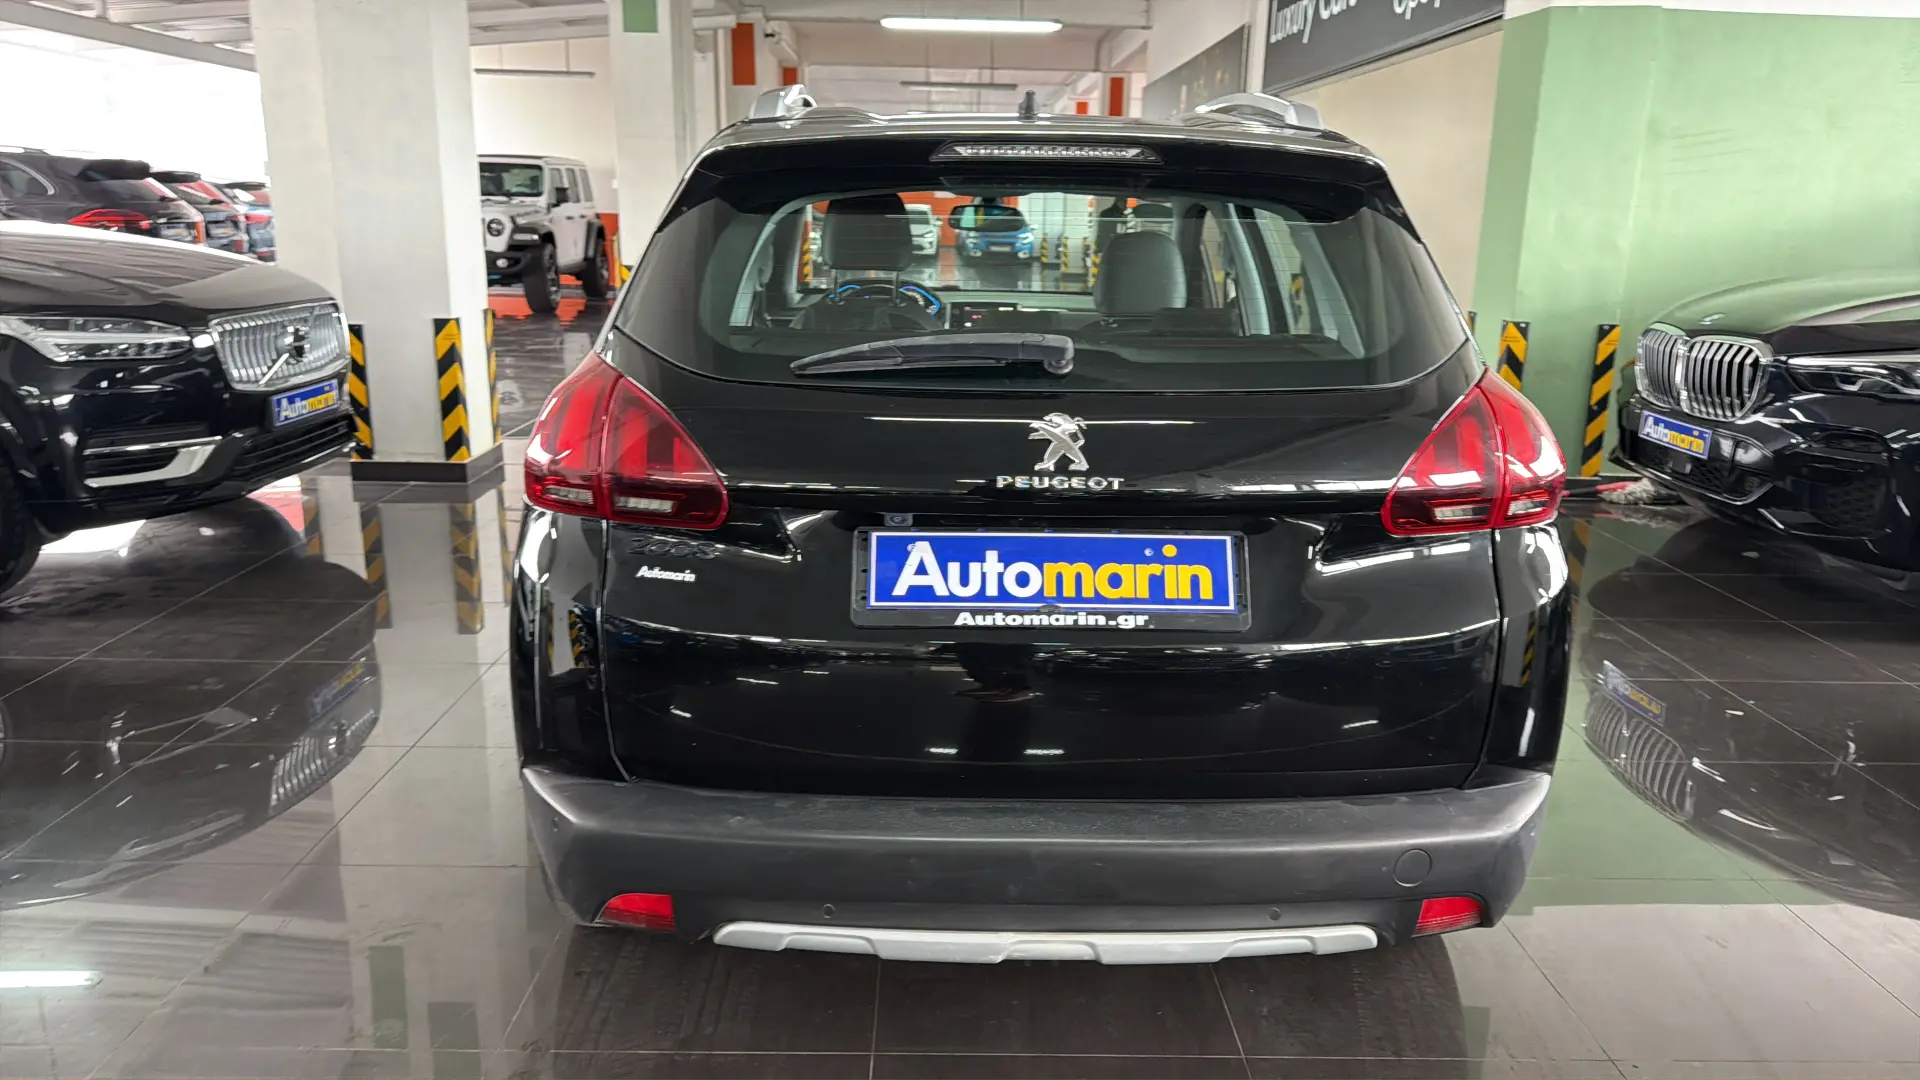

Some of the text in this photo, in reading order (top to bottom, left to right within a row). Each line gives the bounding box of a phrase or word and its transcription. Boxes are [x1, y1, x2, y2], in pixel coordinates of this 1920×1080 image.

[1269, 0, 1317, 43] Luxury
[1642, 417, 1705, 453] Automarin
[995, 475, 1125, 490] PEUGEOT
[892, 541, 1213, 600] Automarin
[953, 611, 1150, 629] Automarin.gr
